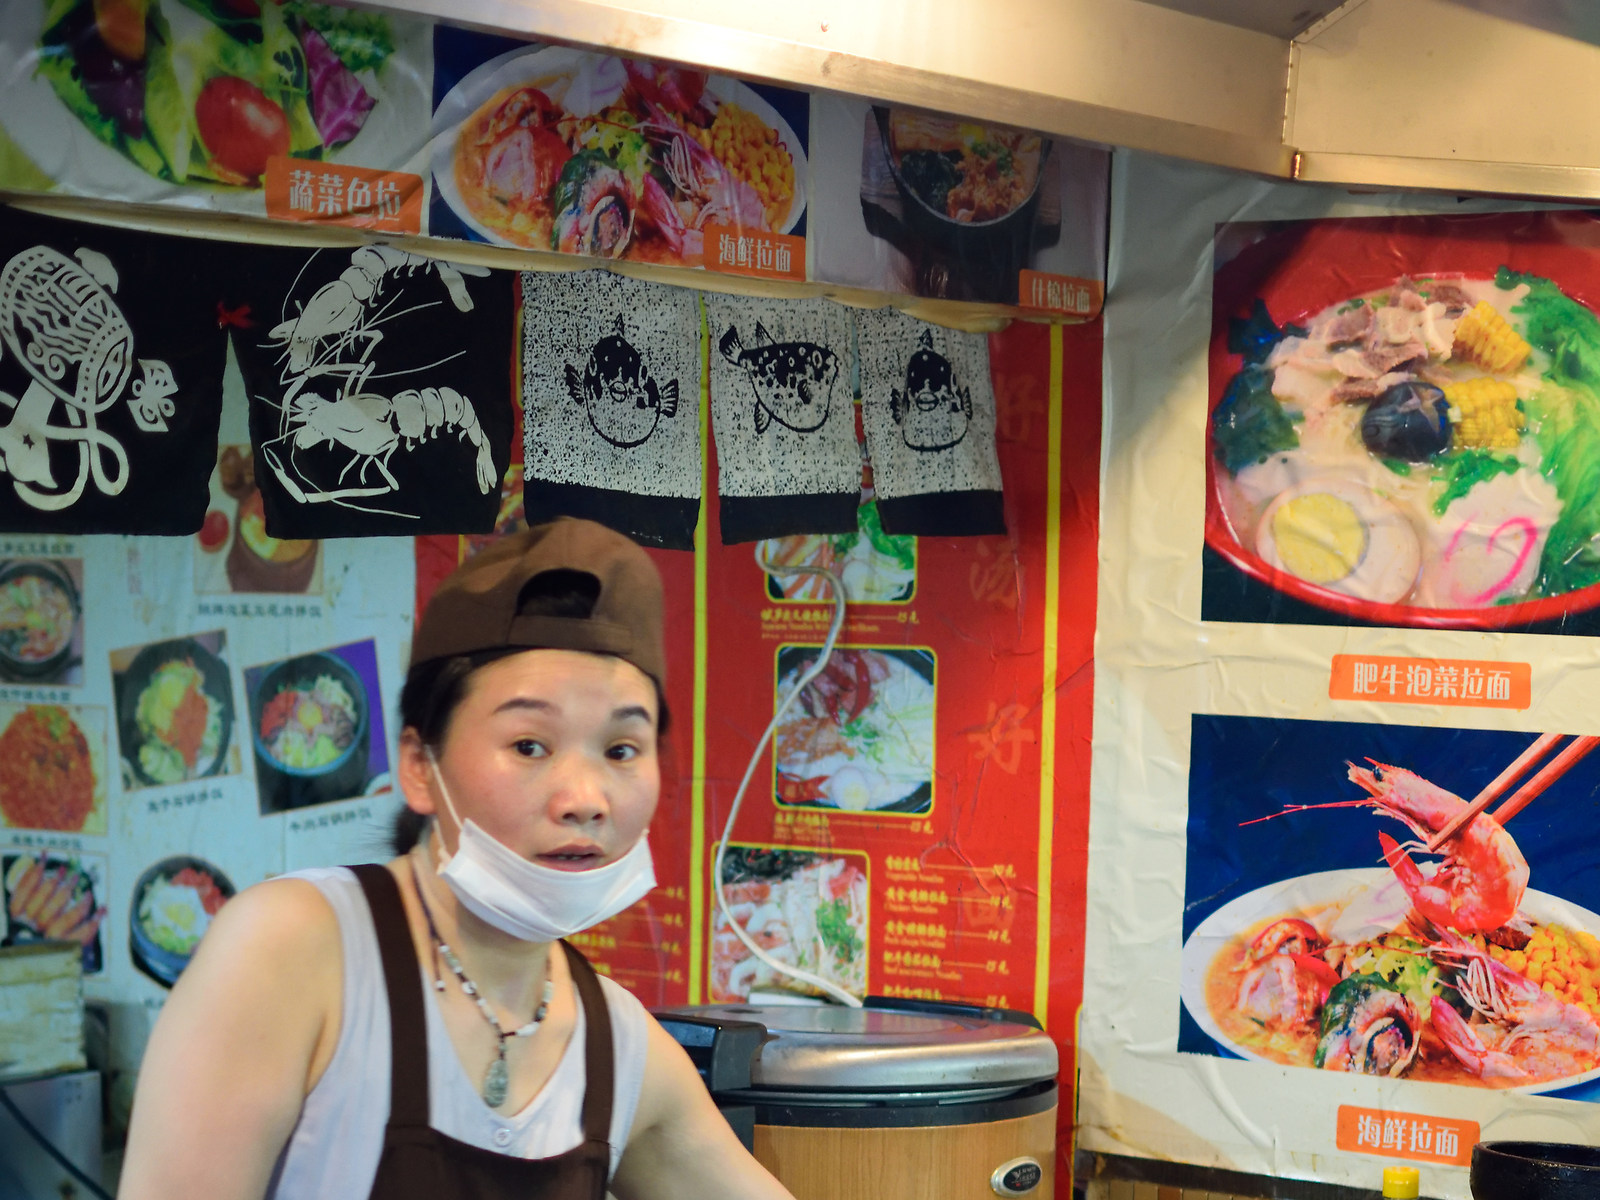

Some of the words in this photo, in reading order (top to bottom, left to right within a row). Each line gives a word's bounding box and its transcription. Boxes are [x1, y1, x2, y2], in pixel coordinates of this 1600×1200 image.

[289, 169, 400, 221] 蔬菜色拉
[719, 233, 791, 272] 海鲜拉面
[1352, 661, 1511, 701] 肥牛泡菜拉面
[1357, 1114, 1460, 1157] 海鲜拉面
